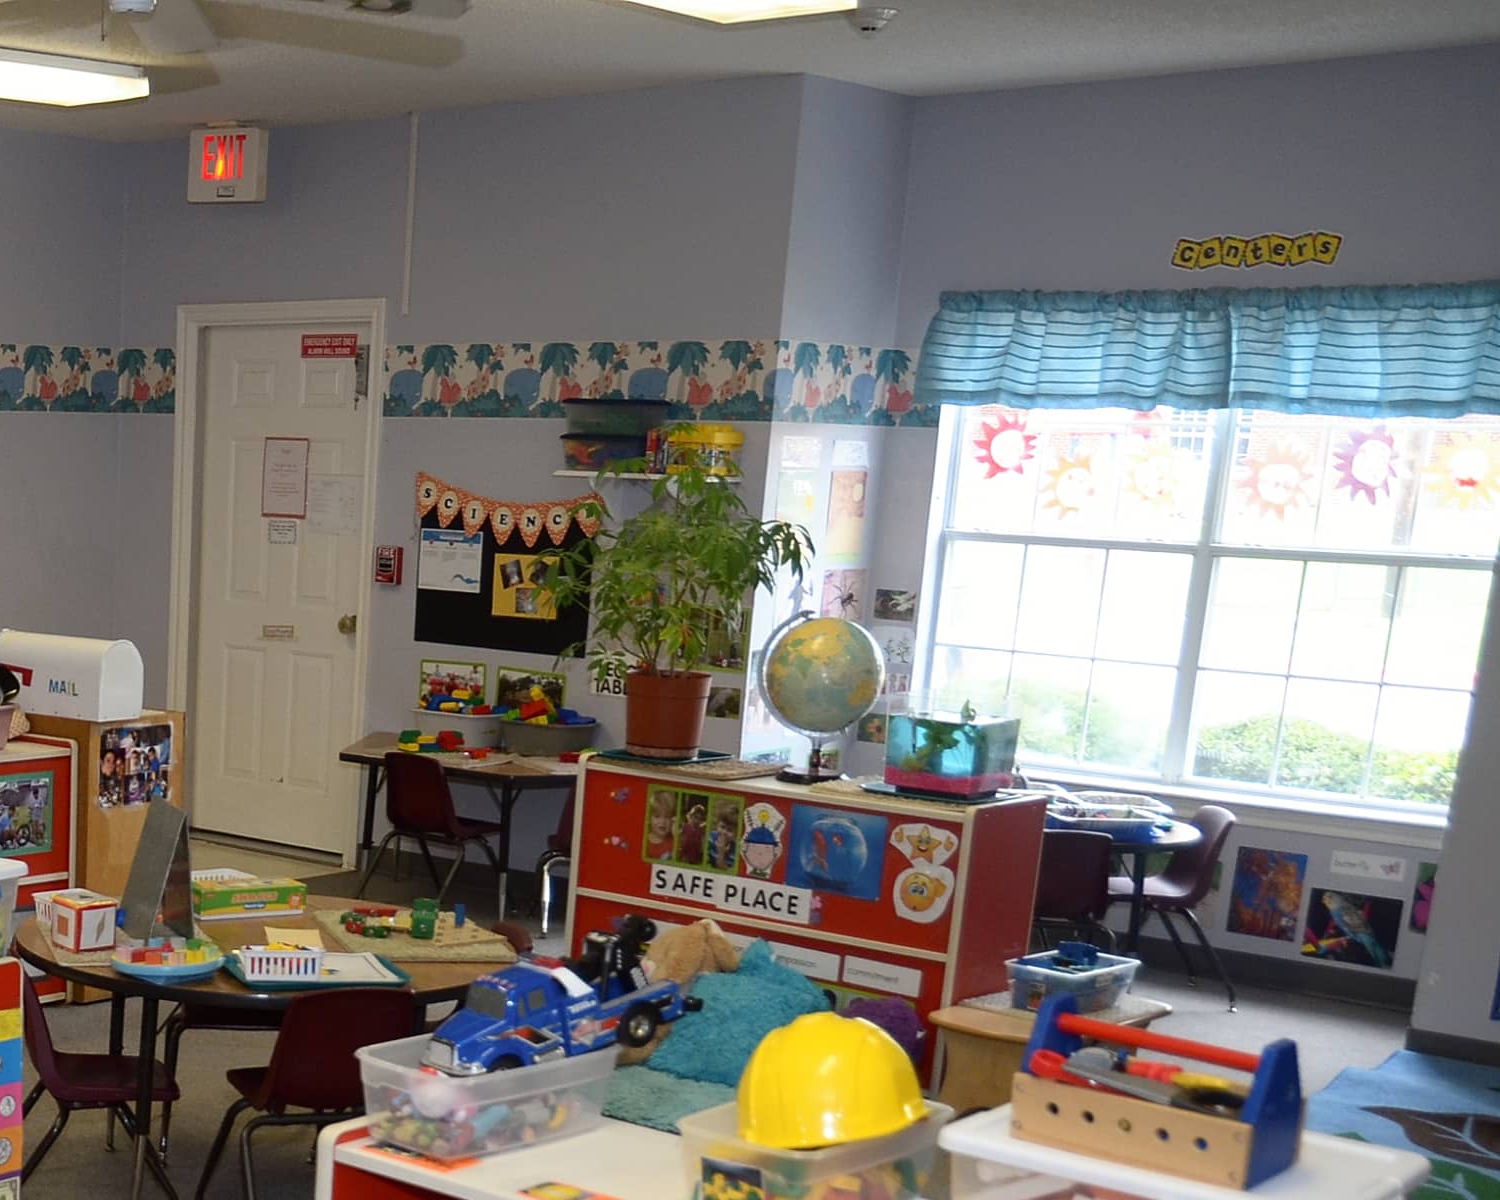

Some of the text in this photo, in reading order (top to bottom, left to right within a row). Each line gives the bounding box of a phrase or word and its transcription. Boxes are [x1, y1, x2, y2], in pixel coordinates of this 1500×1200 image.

[202, 134, 248, 181] EXIT
[423, 487, 564, 528] SCIENC
[48, 677, 79, 697] MAIL
[593, 678, 628, 695] TABL
[654, 868, 800, 916] SAFE PLACE
